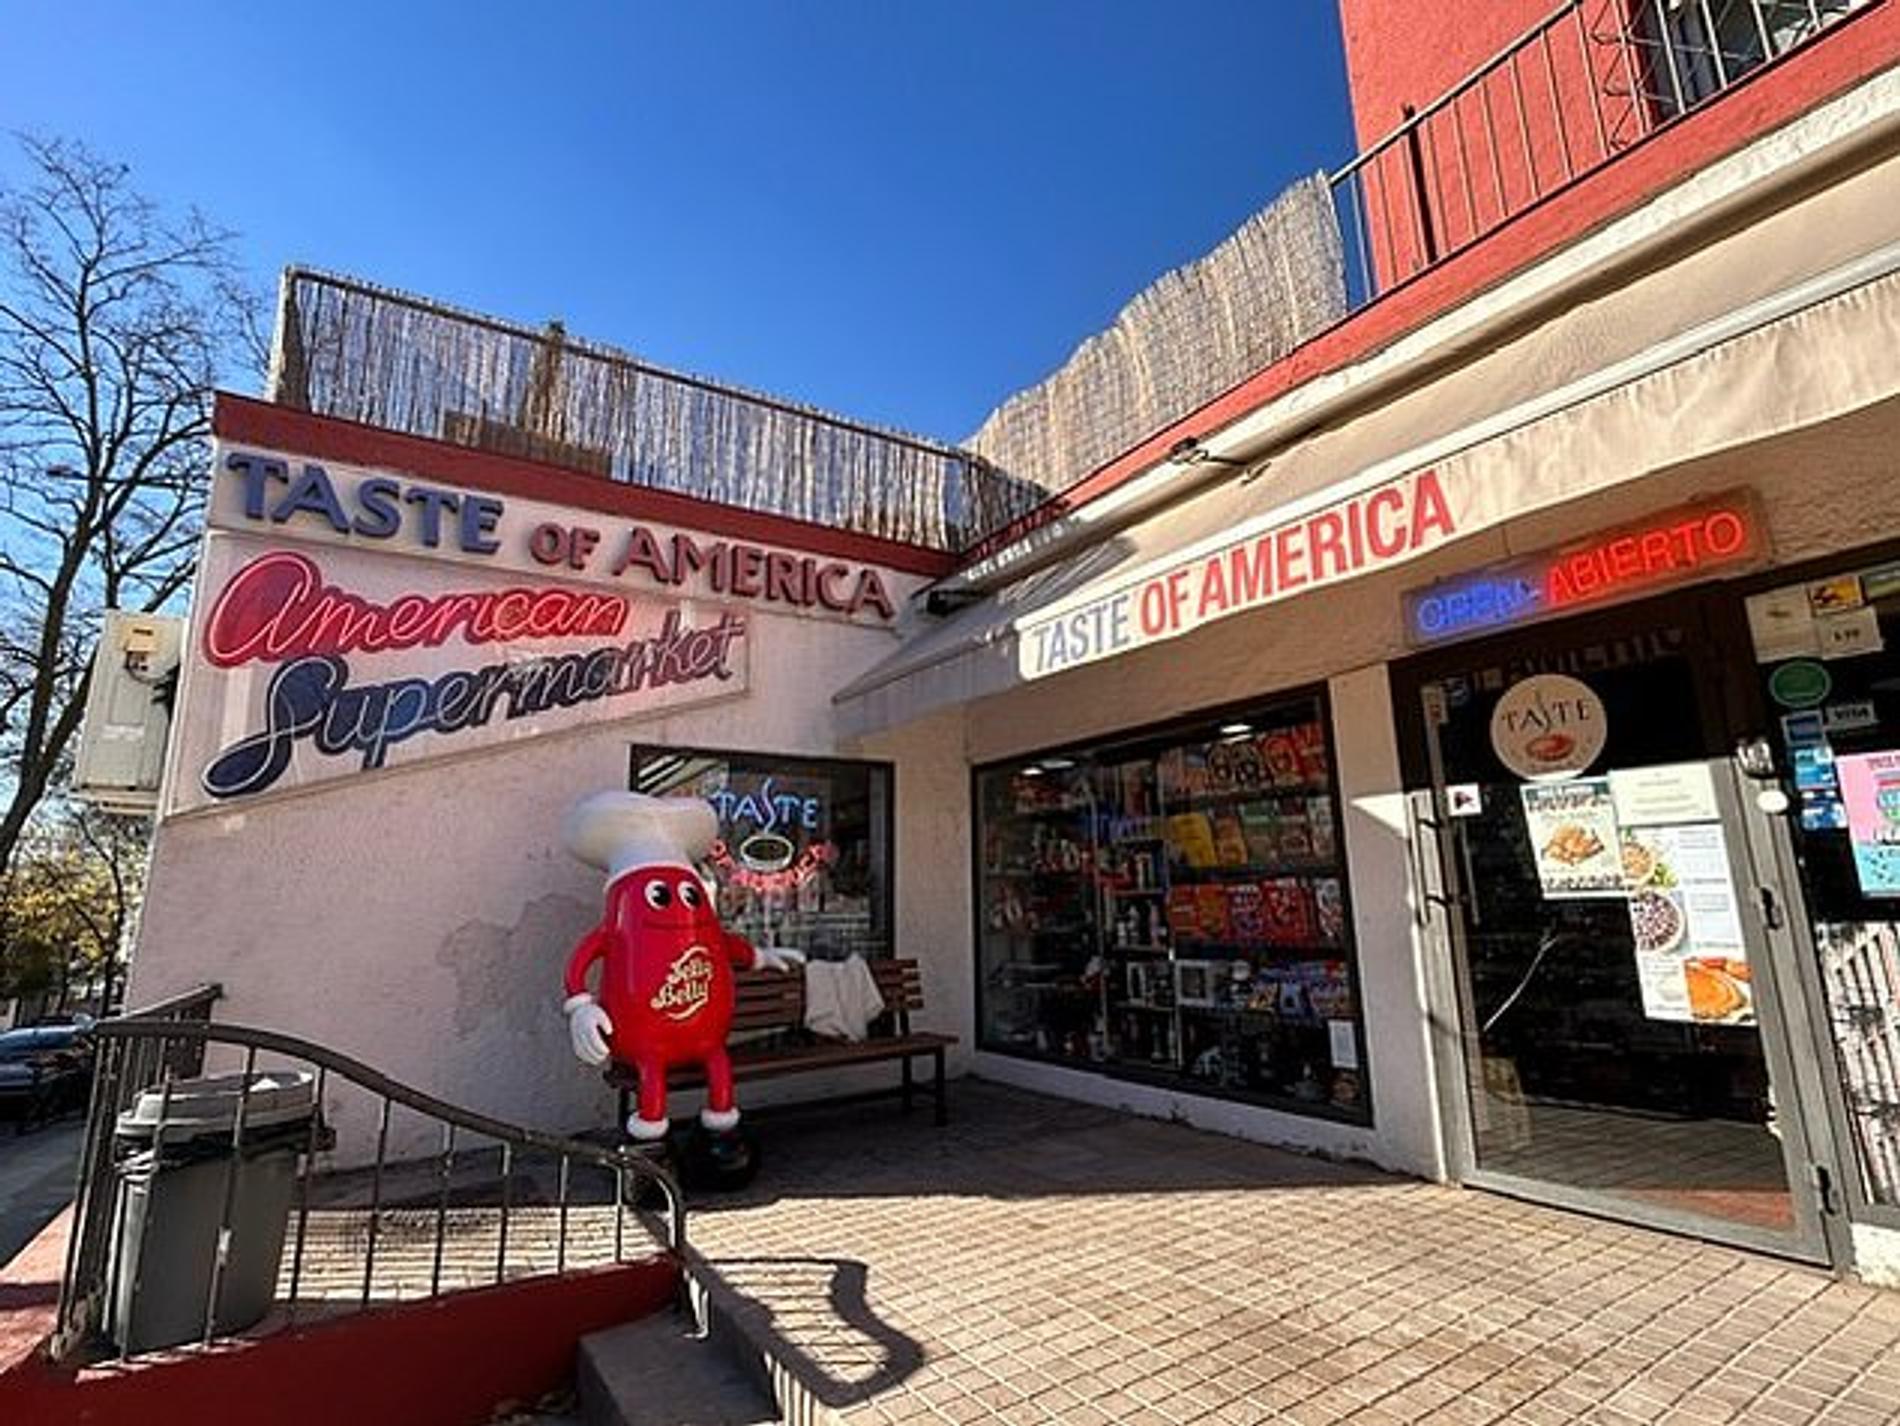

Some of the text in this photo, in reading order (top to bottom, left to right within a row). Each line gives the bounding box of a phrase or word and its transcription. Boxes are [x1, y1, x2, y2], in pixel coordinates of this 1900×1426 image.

[227, 452, 894, 619] TASTE OF AMERICA
[1034, 469, 1455, 673] TASTE OF AMERICA
[1546, 511, 1745, 603] ABIERTO
[204, 550, 630, 669] American
[202, 607, 745, 800] Supermarket
[1502, 691, 1590, 733] TASTE
[710, 777, 818, 835] TASTE
[650, 980, 709, 1011] Belly
